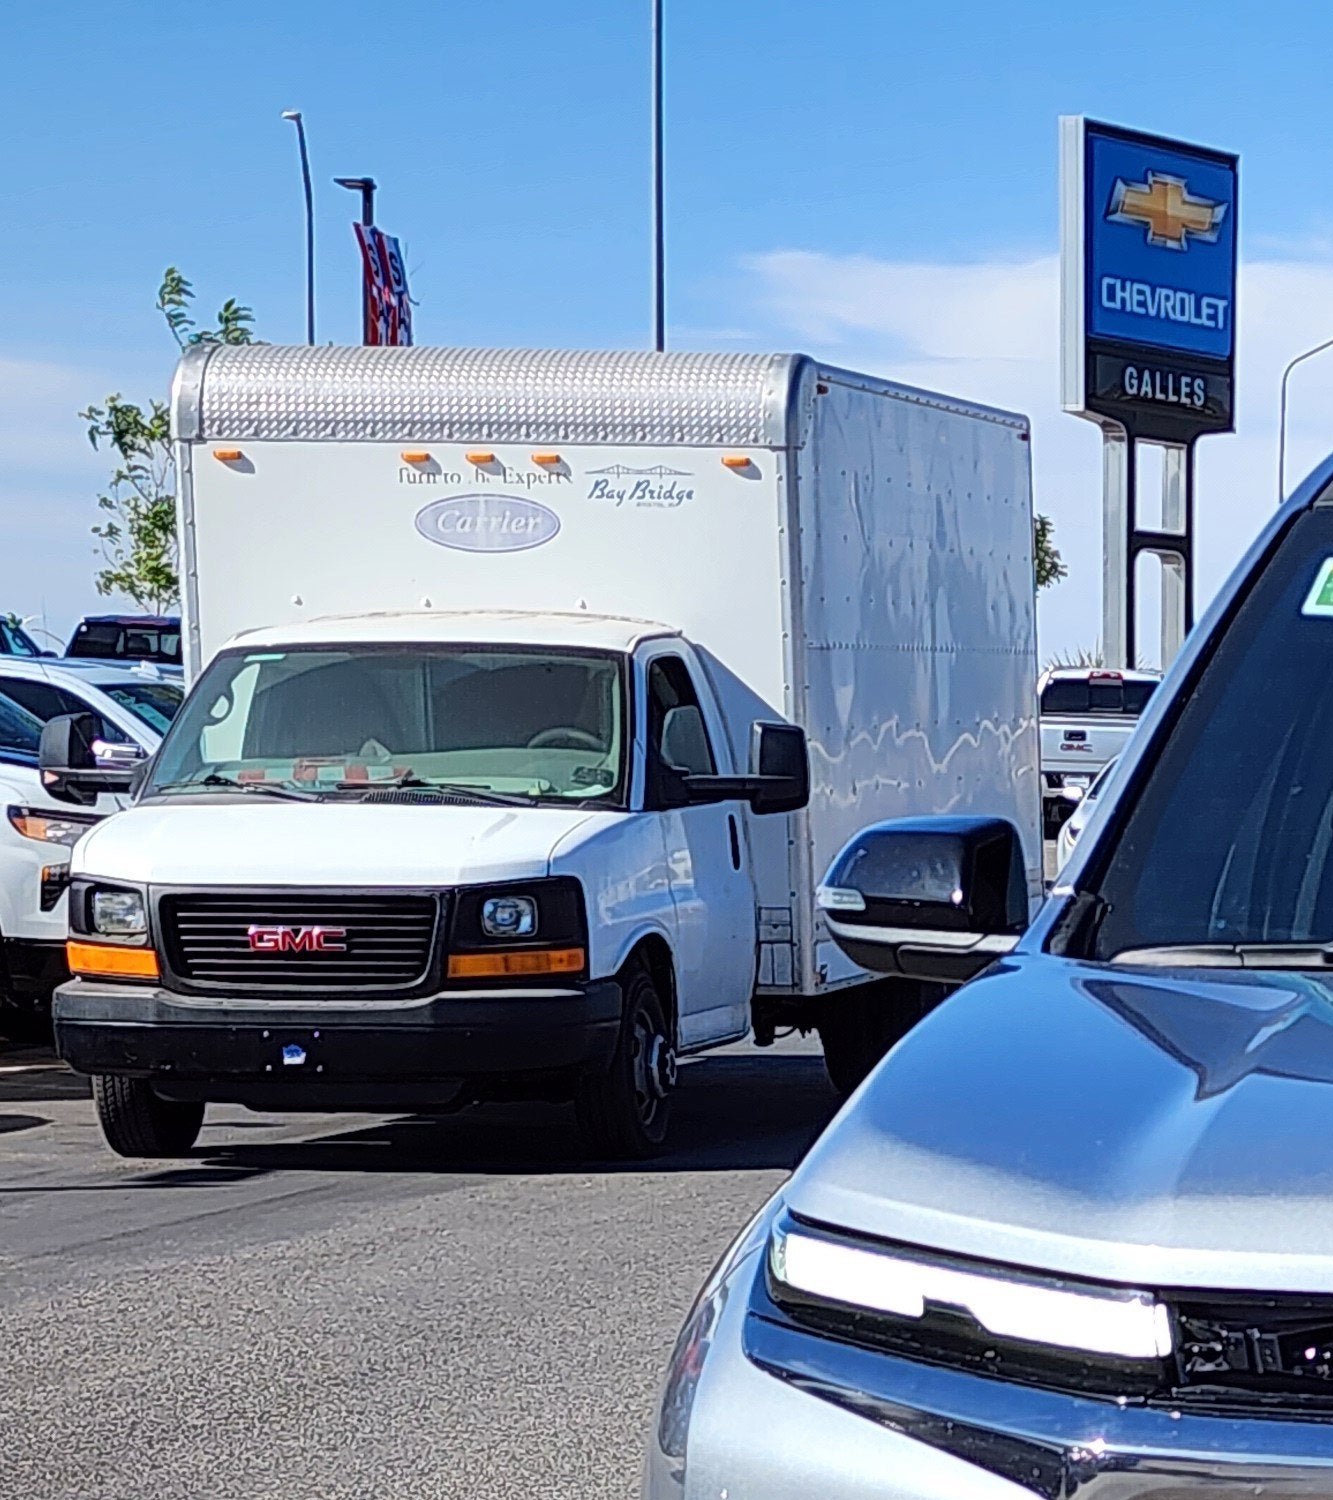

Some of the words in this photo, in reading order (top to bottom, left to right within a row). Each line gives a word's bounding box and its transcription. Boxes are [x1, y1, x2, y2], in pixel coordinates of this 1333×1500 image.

[1101, 276, 1229, 330] CHEVROLET
[1124, 366, 1205, 407] GALLES
[587, 478, 627, 507] Bay
[628, 479, 695, 507] Bridge
[436, 509, 542, 534] Carrier
[248, 925, 347, 953] GMC
